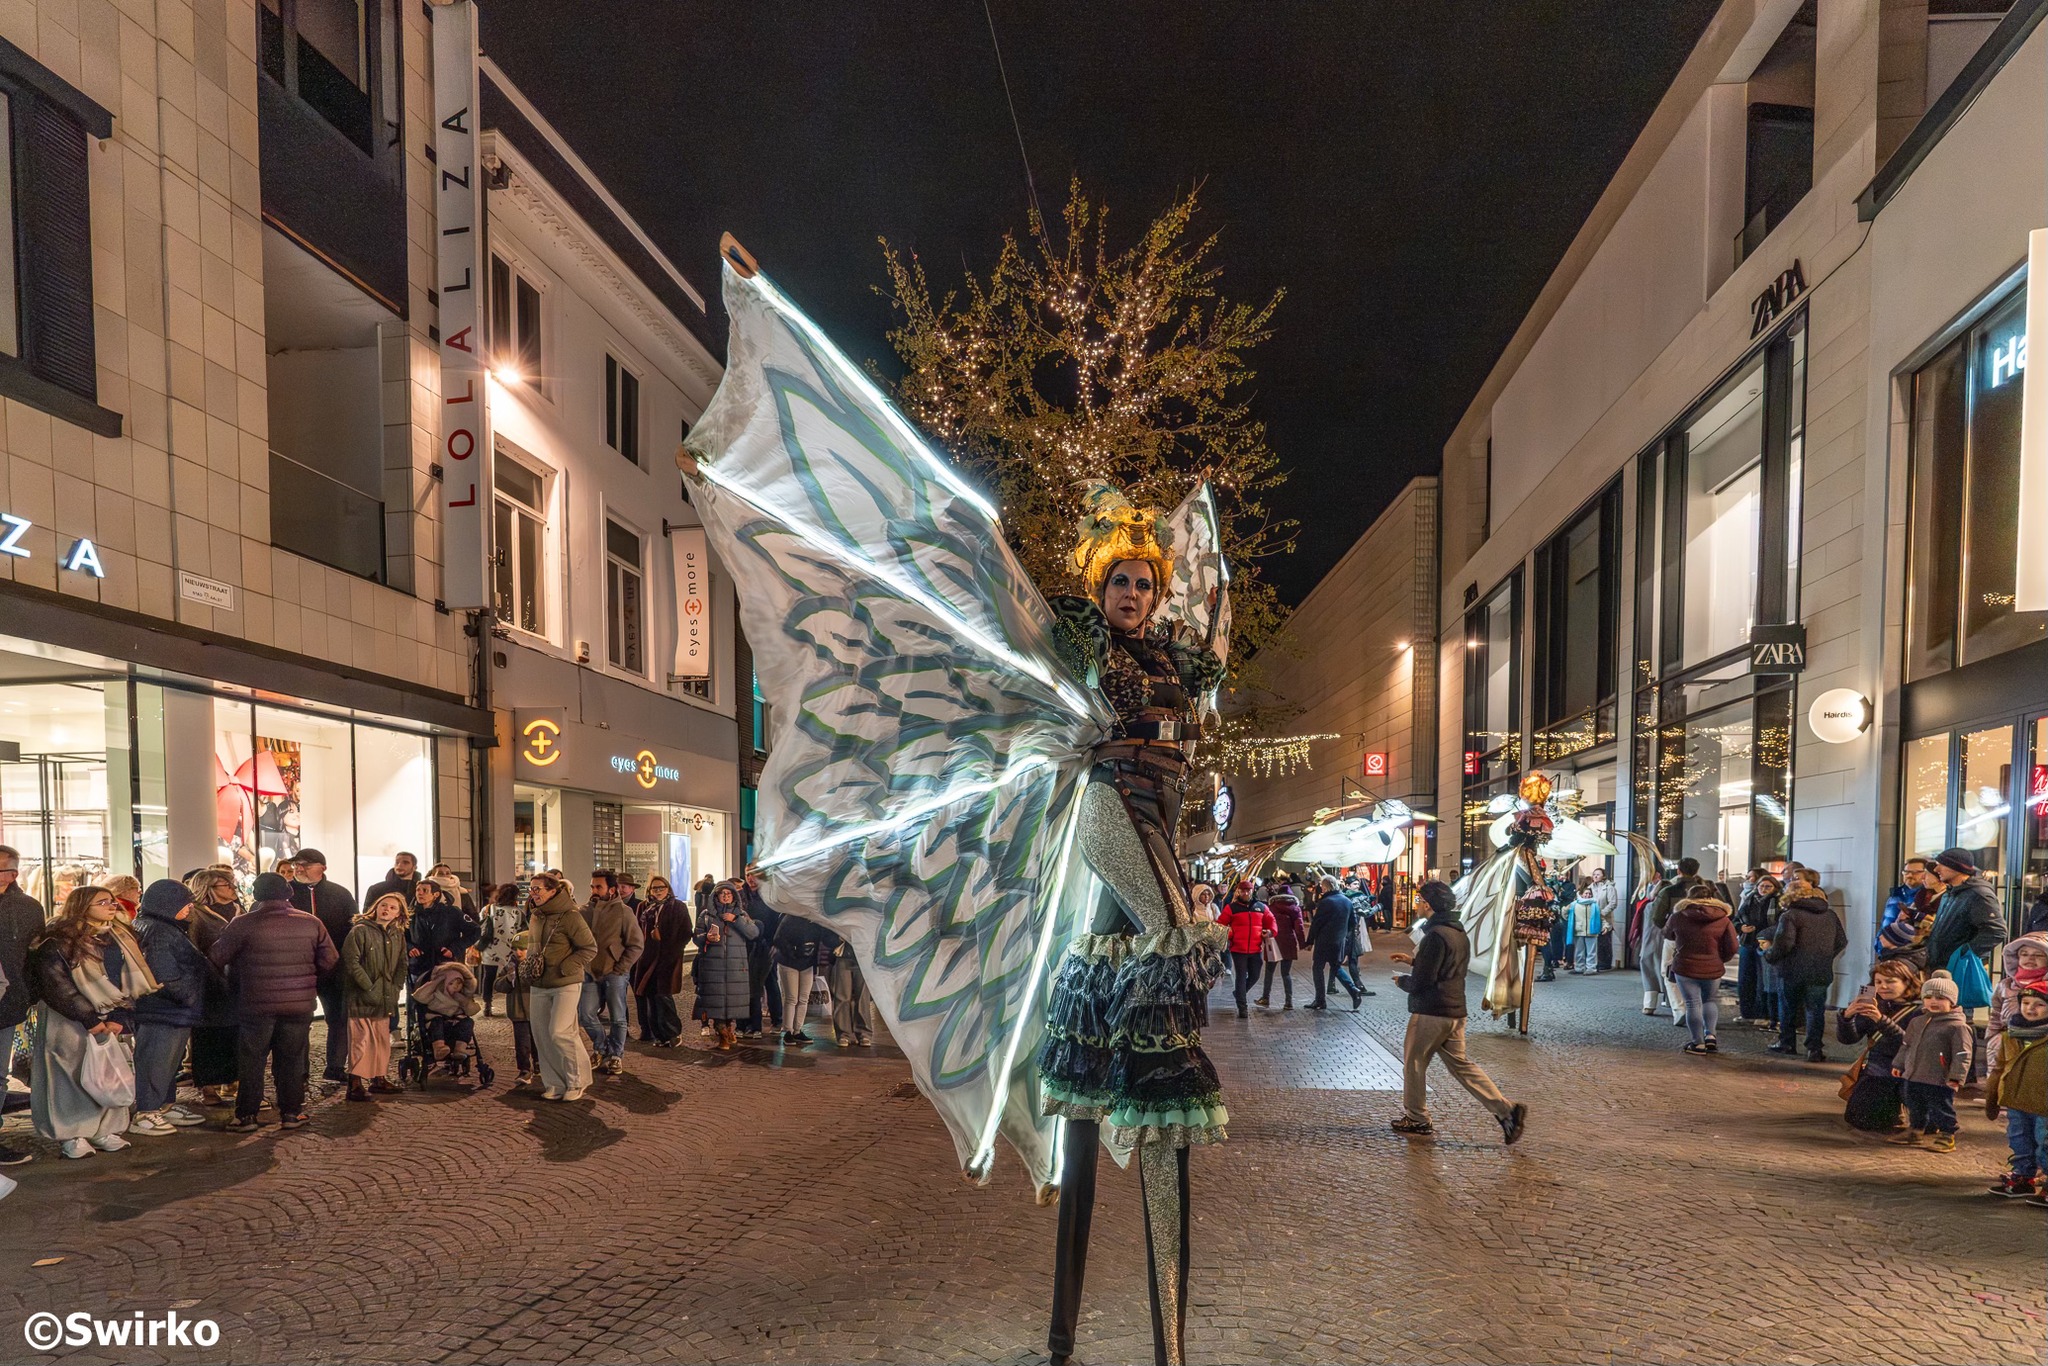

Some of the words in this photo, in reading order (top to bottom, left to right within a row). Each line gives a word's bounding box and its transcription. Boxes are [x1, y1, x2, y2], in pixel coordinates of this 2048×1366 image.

[441, 106, 476, 508] LOLALIZA
[1750, 258, 1810, 340] ZARA
[184, 577, 228, 594] NIEUWSTRAAT
[686, 552, 697, 595] more
[689, 619, 701, 656] eyes
[1753, 642, 1804, 666] ZARA
[1823, 711, 1853, 719] Hairdis
[611, 755, 637, 773] eyes
[655, 764, 680, 781] more
